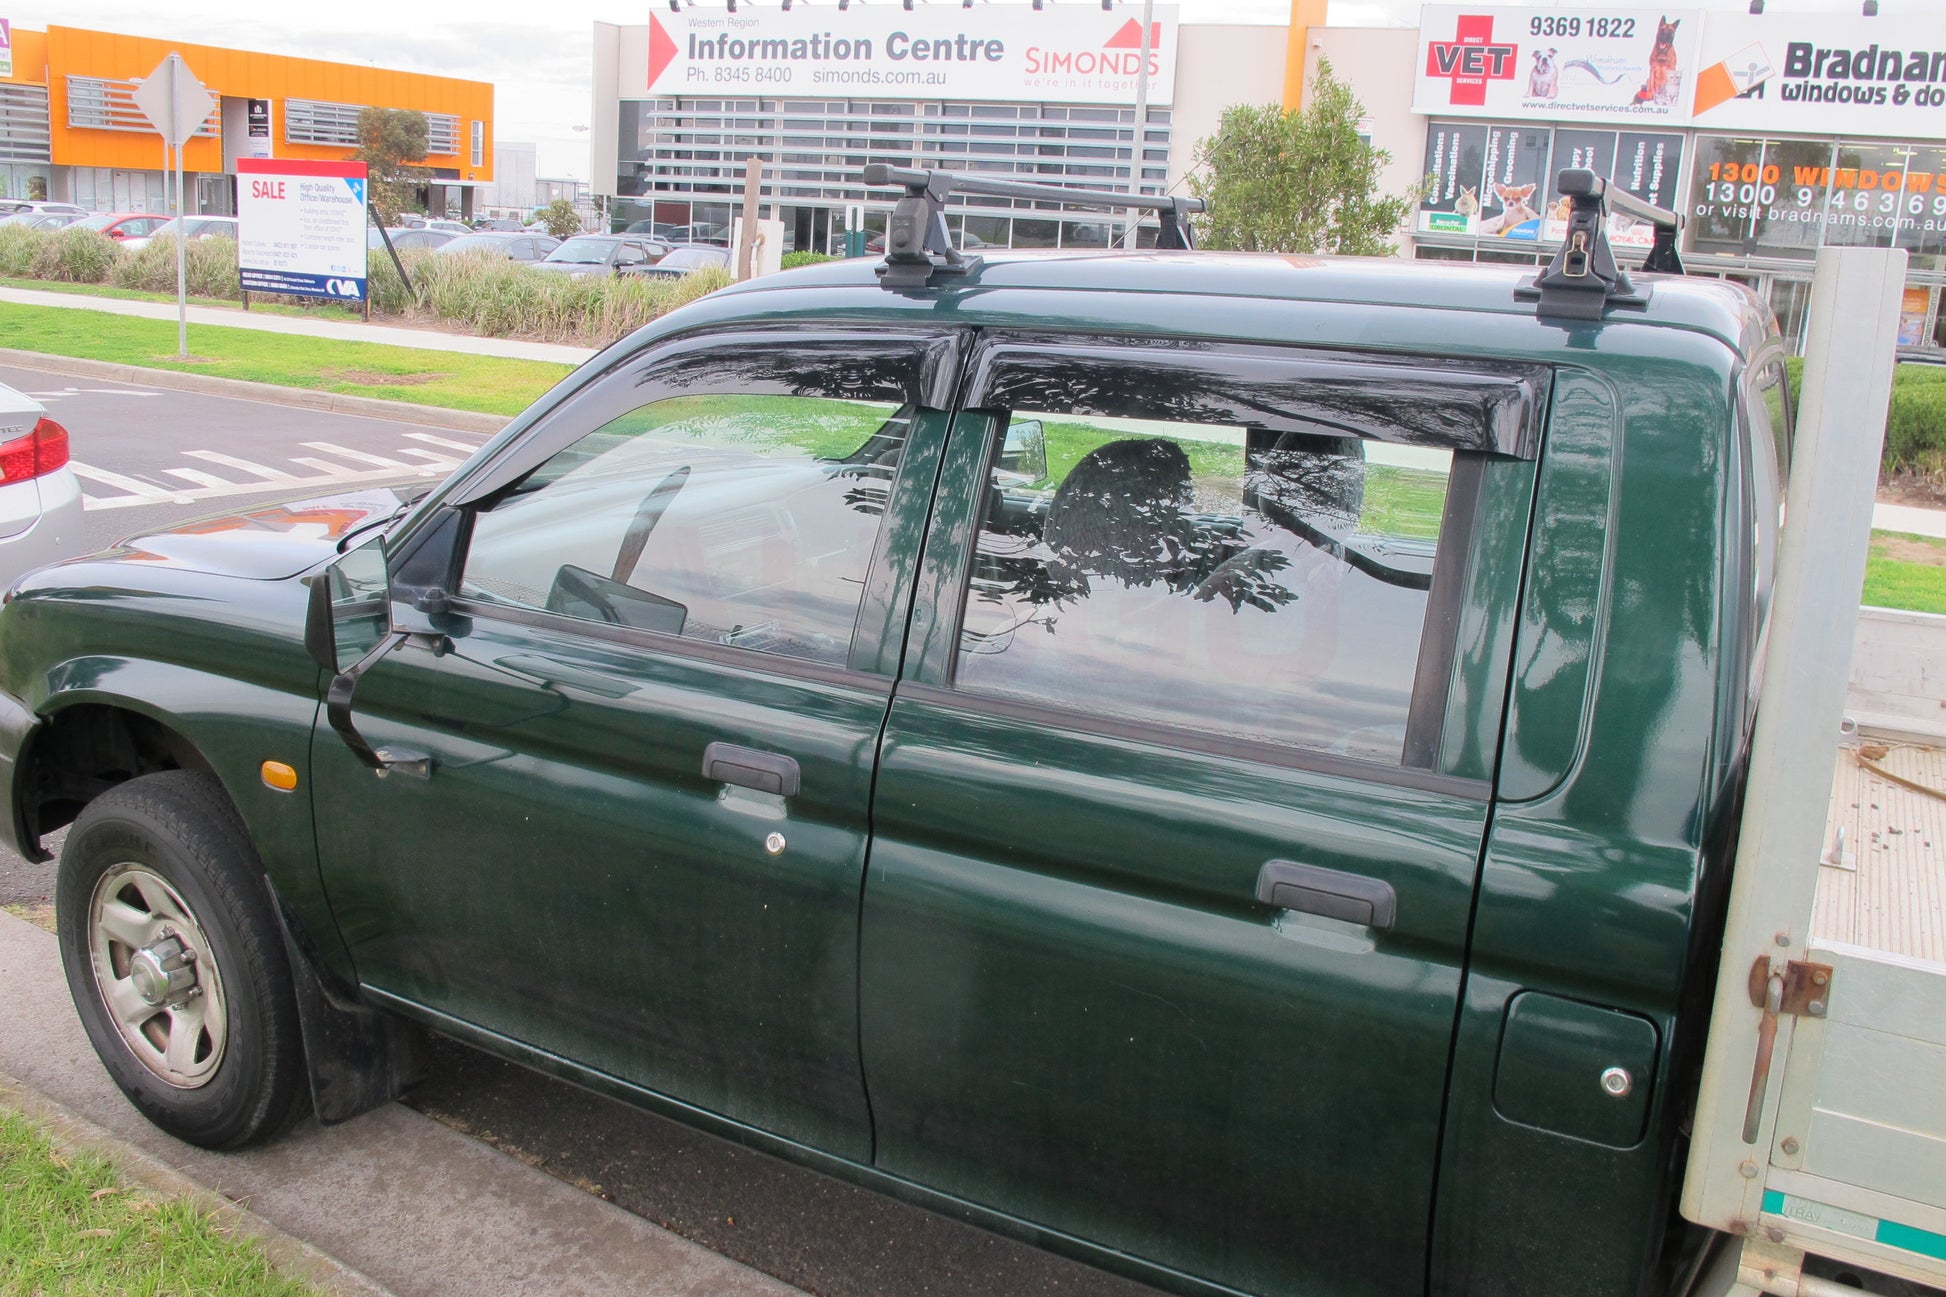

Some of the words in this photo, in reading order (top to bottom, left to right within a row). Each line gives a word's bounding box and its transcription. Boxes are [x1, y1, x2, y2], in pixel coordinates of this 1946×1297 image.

[688, 18, 725, 28] Western
[727, 18, 760, 29] Region
[1530, 16, 1580, 37] 9369
[1586, 17, 1636, 39] 1822
[688, 32, 873, 61] Information
[885, 31, 1005, 62] Centre
[1464, 36, 1484, 44] DIRECT
[1025, 47, 1161, 77] SIMONDS
[1434, 45, 1512, 76] VET
[687, 67, 709, 83] Ph.
[714, 67, 750, 83] 8345
[755, 68, 792, 84] 8400
[813, 68, 946, 86] simonds.com.au
[1024, 78, 1059, 89] we're
[1065, 79, 1077, 89] in
[1083, 79, 1093, 89] it
[1098, 79, 1158, 92] togetr
[1456, 77, 1483, 85] SERVICES
[1781, 81, 1888, 106] windows
[1892, 83, 1911, 107] &
[1914, 84, 1946, 108] do
[1521, 101, 1669, 116] www.directvetservices.com.au
[1444, 132, 1461, 201] Vaccinations
[1483, 131, 1502, 207] Microchipping
[1503, 131, 1519, 184] Grooming
[1571, 147, 1582, 169] ppy
[1584, 146, 1595, 170] hool
[1630, 141, 1646, 191] Nutrition
[1648, 142, 1665, 191] Supplies
[252, 180, 286, 200] SALE
[300, 183, 314, 193] High
[314, 183, 336, 194] Quality
[1708, 162, 1781, 185] 1300
[1794, 166, 1946, 194] WINDOWS
[1706, 182, 1776, 206] 1300
[1696, 204, 1715, 217] or
[1722, 205, 1762, 220] visit
[1769, 206, 1946, 232] bradnams.com.au
[326, 278, 361, 297] CVA
